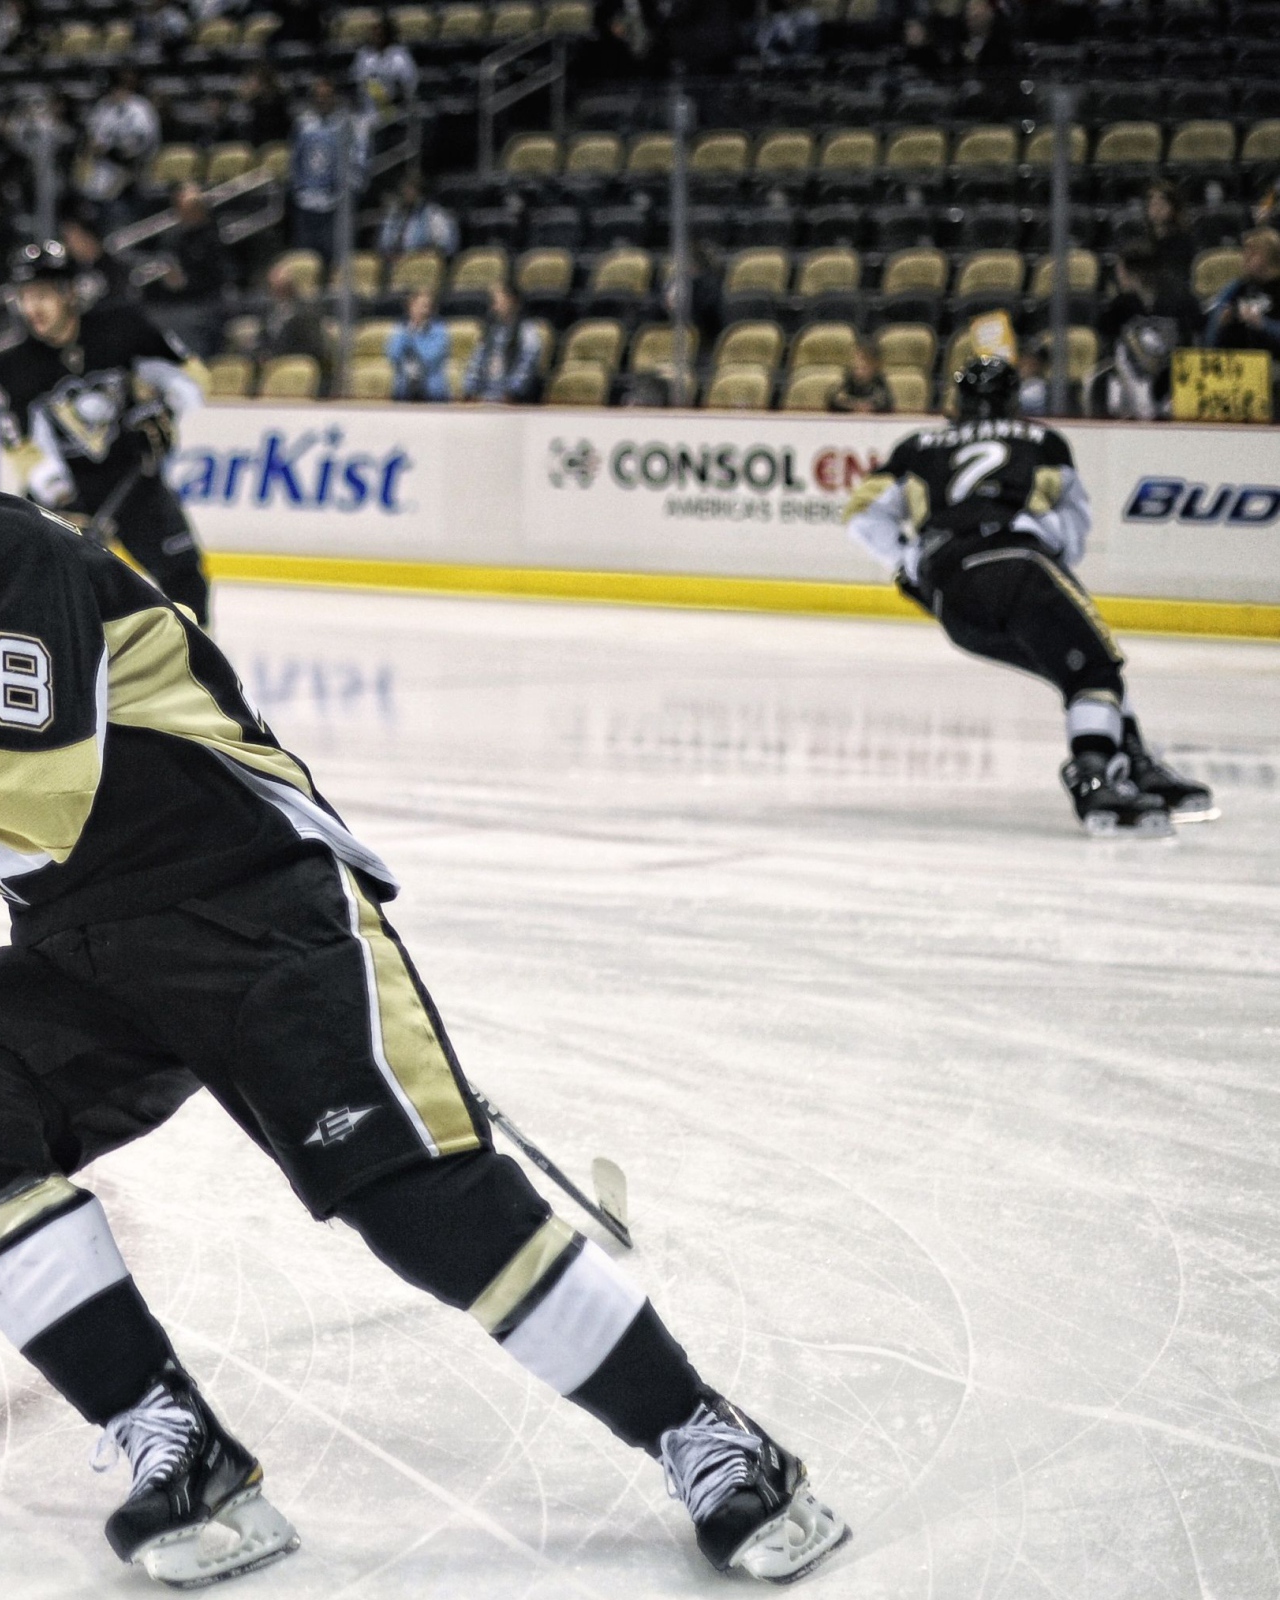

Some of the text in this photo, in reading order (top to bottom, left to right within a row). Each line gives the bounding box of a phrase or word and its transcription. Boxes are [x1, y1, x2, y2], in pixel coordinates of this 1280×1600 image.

[610, 439, 805, 492] CONSOL
[945, 439, 1011, 506] 2
[1123, 475, 1280, 527] BUD
